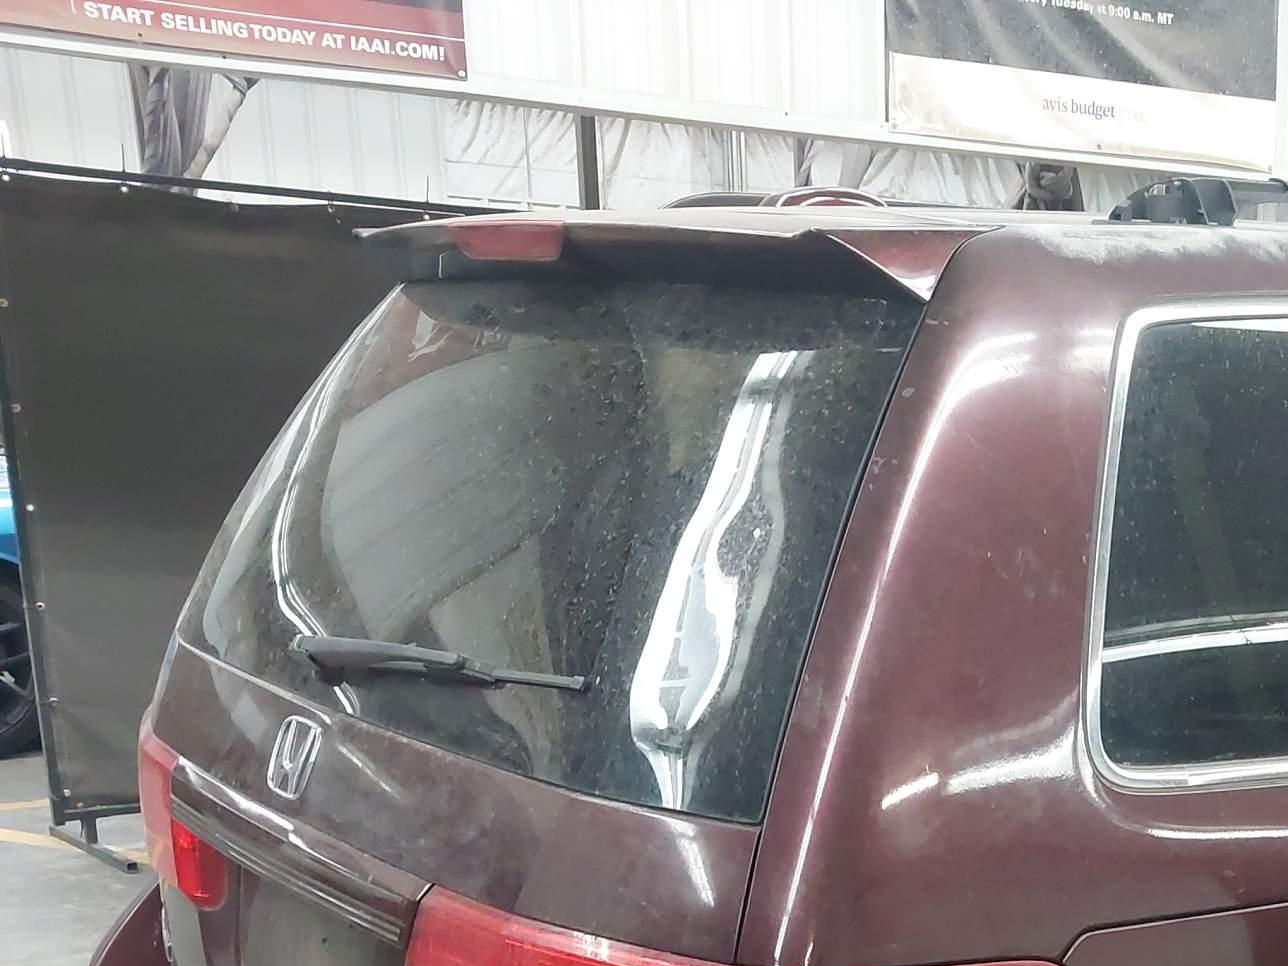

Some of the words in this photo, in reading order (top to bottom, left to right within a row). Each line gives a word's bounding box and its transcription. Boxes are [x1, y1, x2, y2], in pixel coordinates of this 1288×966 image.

[1132, 10, 1155, 23] a.m.
[1157, 11, 1175, 25] MT
[83, 1, 154, 26] START
[160, 12, 249, 38] SELLING
[250, 24, 316, 46] TODAY
[321, 33, 345, 49] AT
[350, 35, 445, 61] IAAI.COM!
[1042, 96, 1068, 113] avis
[1071, 98, 1116, 121] budget
